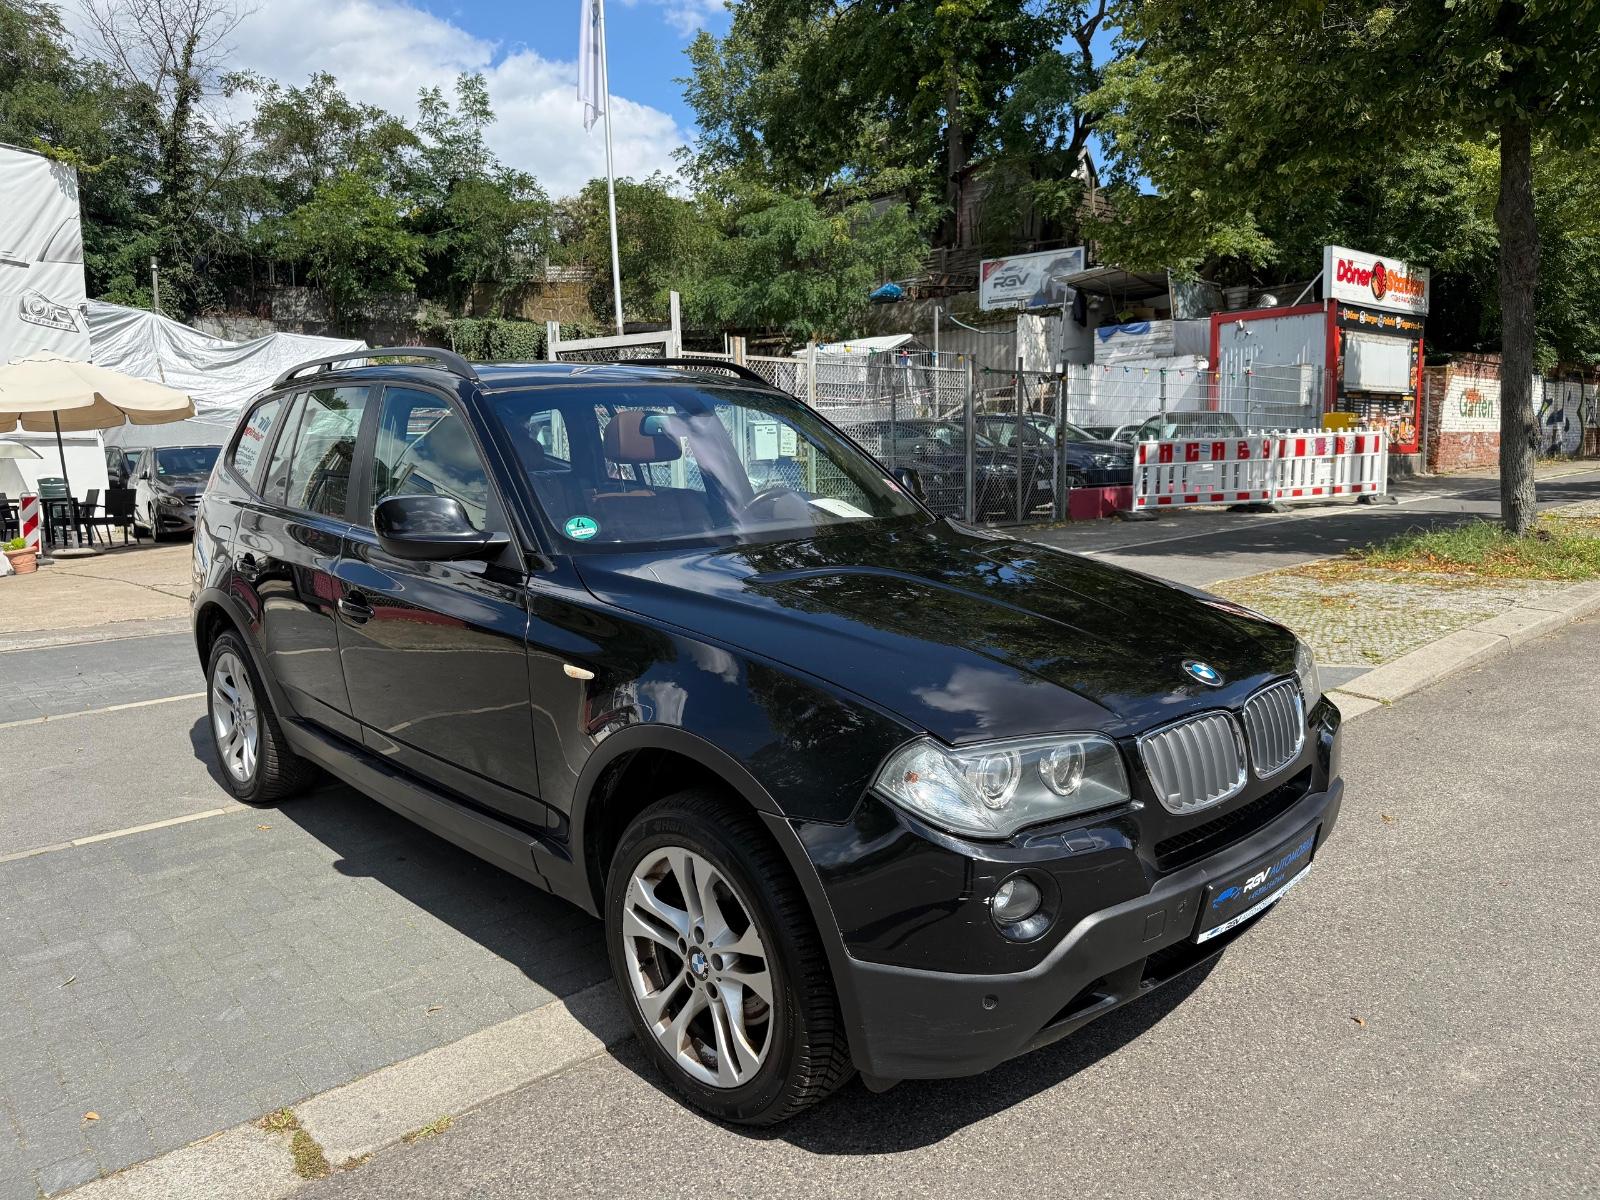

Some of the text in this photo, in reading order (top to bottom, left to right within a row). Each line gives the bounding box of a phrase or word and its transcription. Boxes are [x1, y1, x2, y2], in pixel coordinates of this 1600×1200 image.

[993, 273, 1030, 288] RGV
[1337, 259, 1373, 287] Döner
[576, 518, 586, 528] 4
[1243, 867, 1271, 893] RGV
